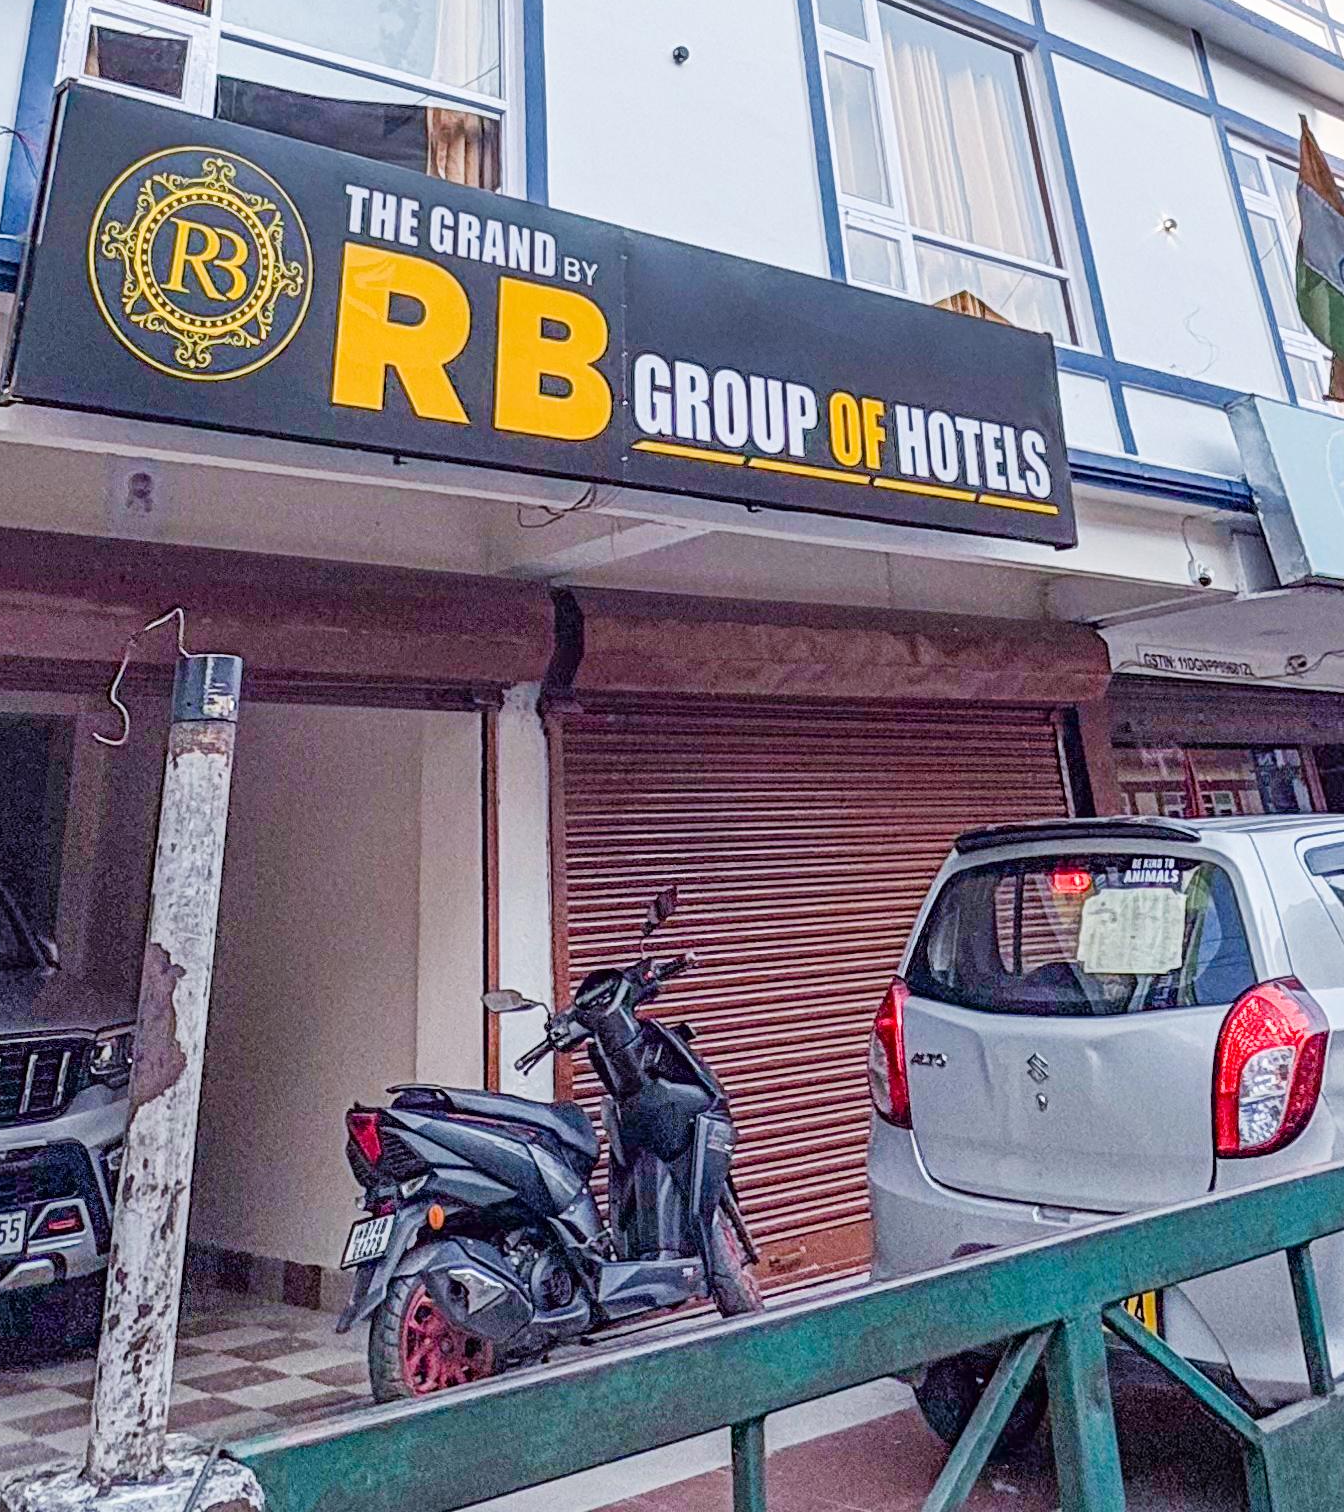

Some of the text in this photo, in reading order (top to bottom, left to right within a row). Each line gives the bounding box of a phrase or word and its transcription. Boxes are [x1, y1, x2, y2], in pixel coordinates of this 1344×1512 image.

[345, 183, 598, 287] THE GRAND BY
[332, 241, 613, 441] RB
[632, 353, 1053, 500] GROUP OF HOTELS
[1123, 869, 1180, 883] ANIMALS
[1132, 858, 1175, 869] BE KIND TO
